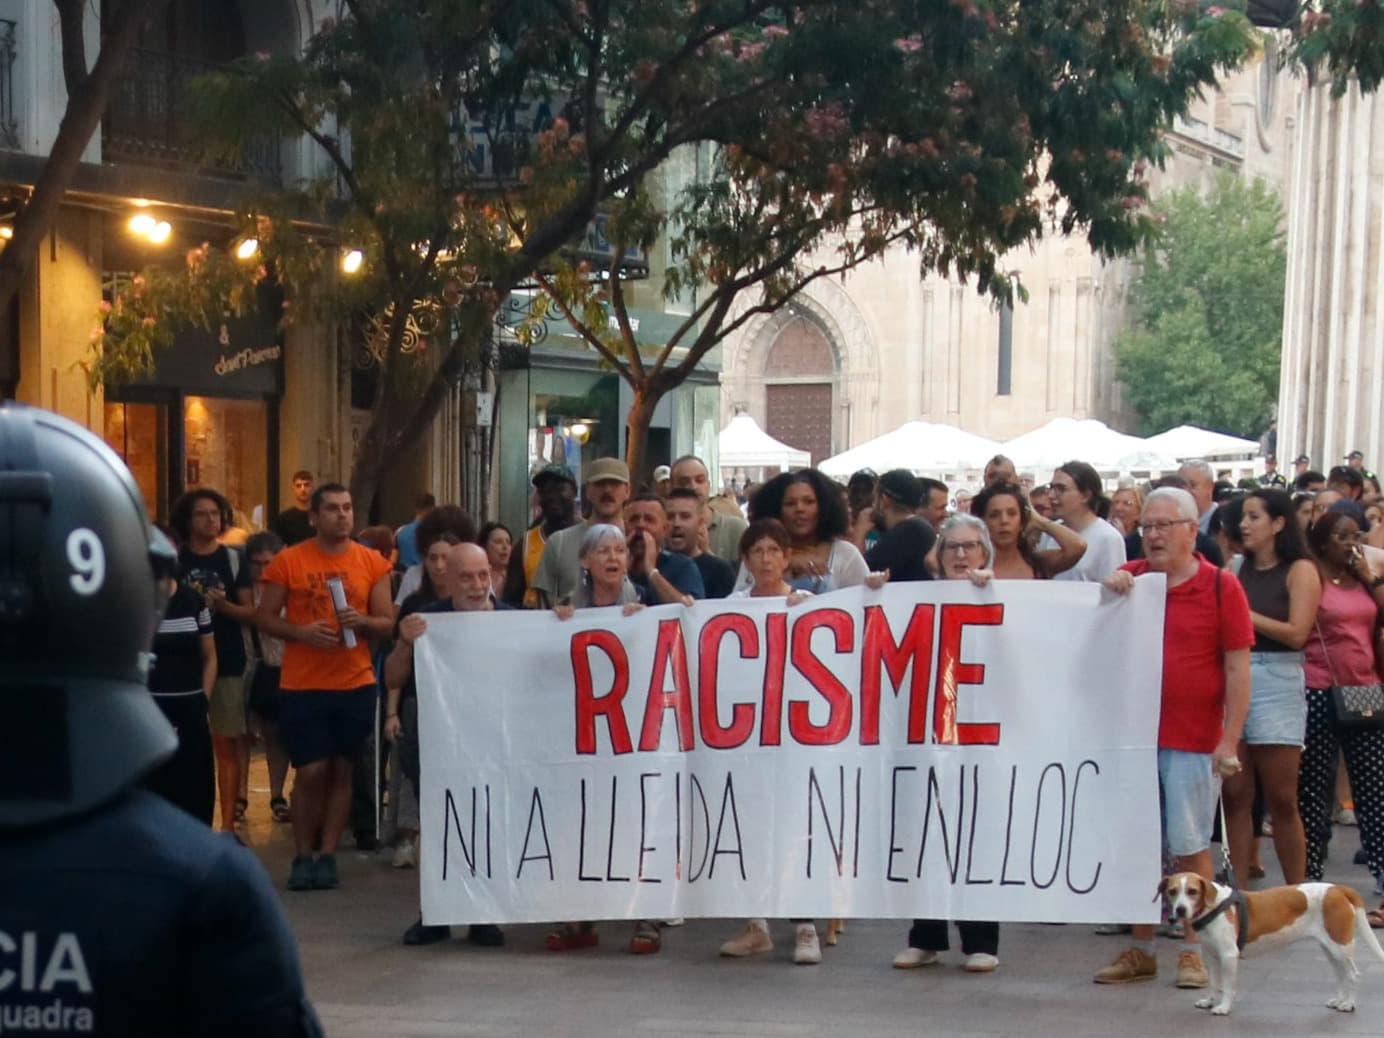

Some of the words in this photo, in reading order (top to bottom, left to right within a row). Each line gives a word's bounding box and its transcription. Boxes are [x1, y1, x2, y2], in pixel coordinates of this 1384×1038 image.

[65, 527, 106, 595] 9
[571, 602, 1004, 754] RACISME
[442, 783, 492, 880] NI
[516, 786, 554, 880] A
[578, 770, 746, 884] LLEIDA
[806, 764, 861, 878] NI
